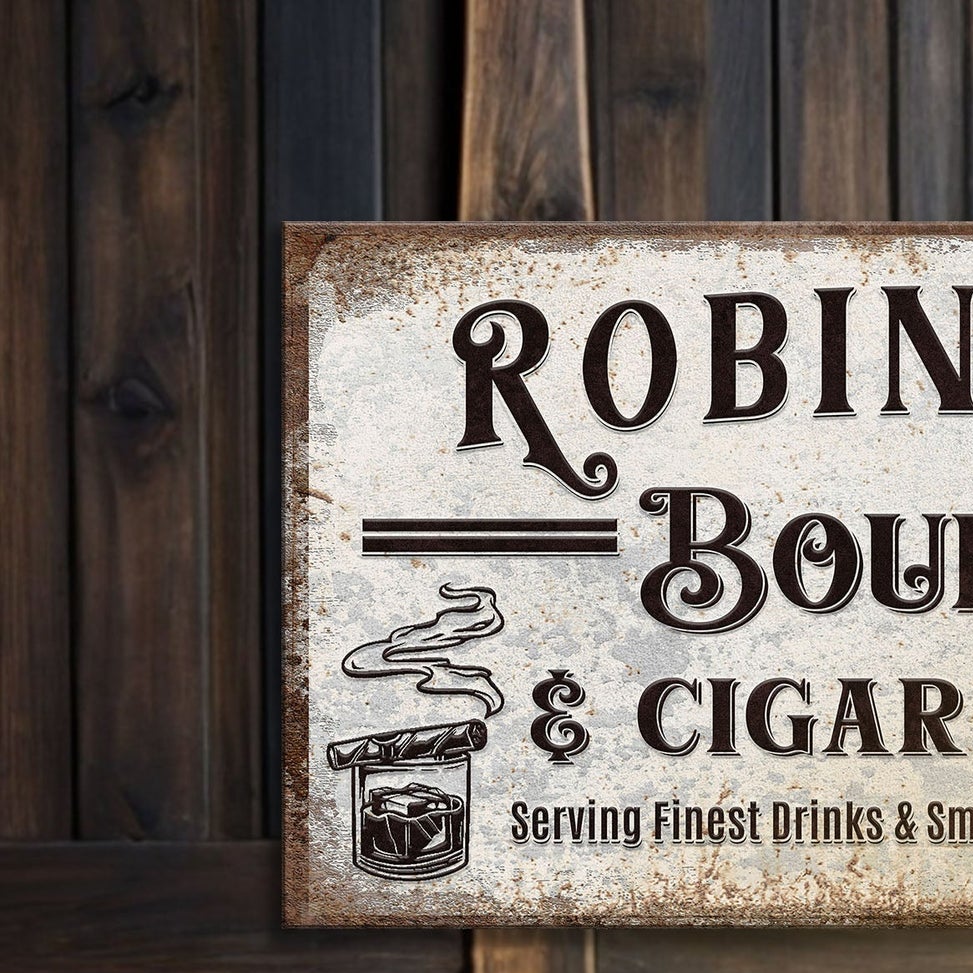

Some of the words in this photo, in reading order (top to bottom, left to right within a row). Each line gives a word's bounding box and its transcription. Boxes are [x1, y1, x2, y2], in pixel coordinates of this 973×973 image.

[530, 669, 590, 763] &
[637, 676, 965, 757] CIGAR
[511, 800, 641, 847] Serving
[651, 800, 761, 843] Finest
[772, 800, 883, 843] Drinks
[895, 801, 917, 843] &
